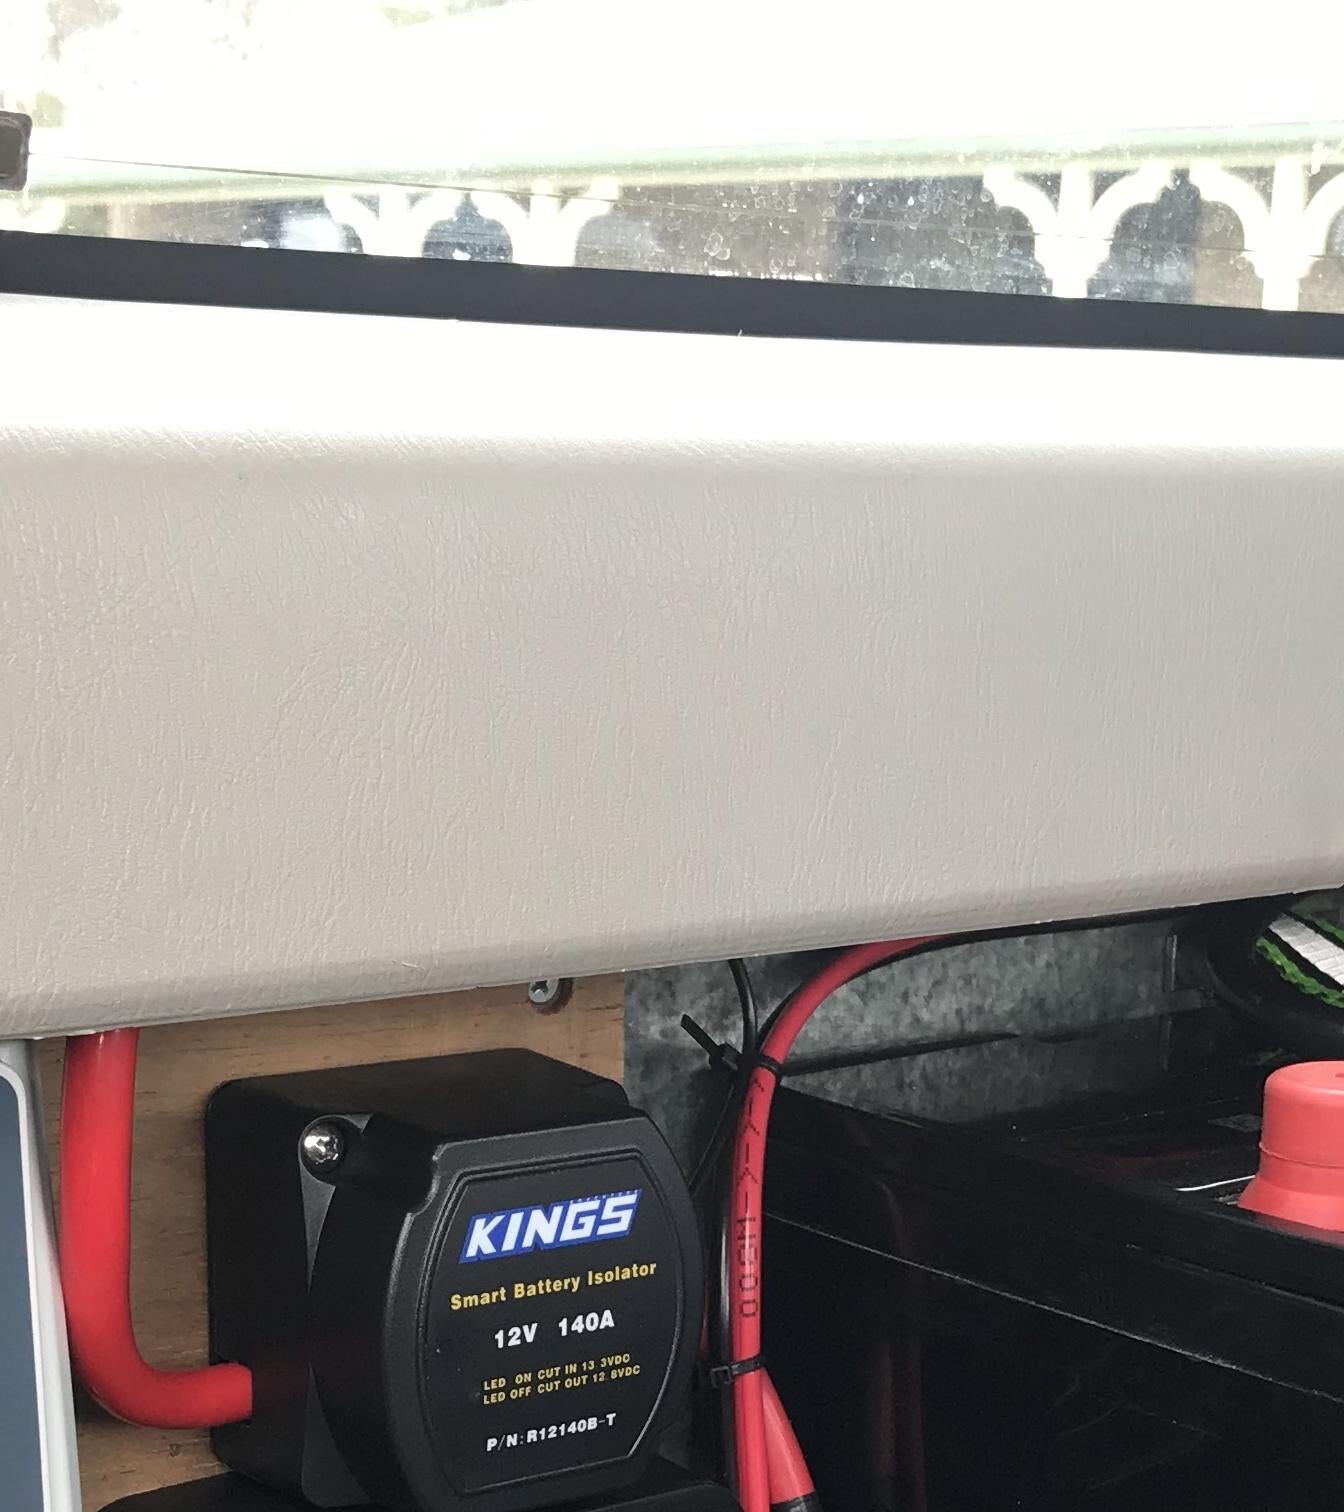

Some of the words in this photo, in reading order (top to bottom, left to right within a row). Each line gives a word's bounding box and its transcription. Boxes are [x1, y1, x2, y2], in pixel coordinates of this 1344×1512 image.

[464, 1194, 639, 1258] KINGS
[449, 1288, 507, 1311] Smart
[513, 1275, 582, 1300] Battery
[587, 1262, 657, 1286] Isolator
[493, 1323, 539, 1349] 12V
[558, 1309, 616, 1338] 140A
[483, 1377, 507, 1391] LED
[514, 1372, 532, 1385] ON
[537, 1366, 561, 1380] CUT
[564, 1362, 578, 1375] IN
[483, 1391, 506, 1405] LED
[509, 1386, 532, 1400] OFF
[537, 1380, 561, 1394] CUT
[564, 1374, 589, 1389] OUT
